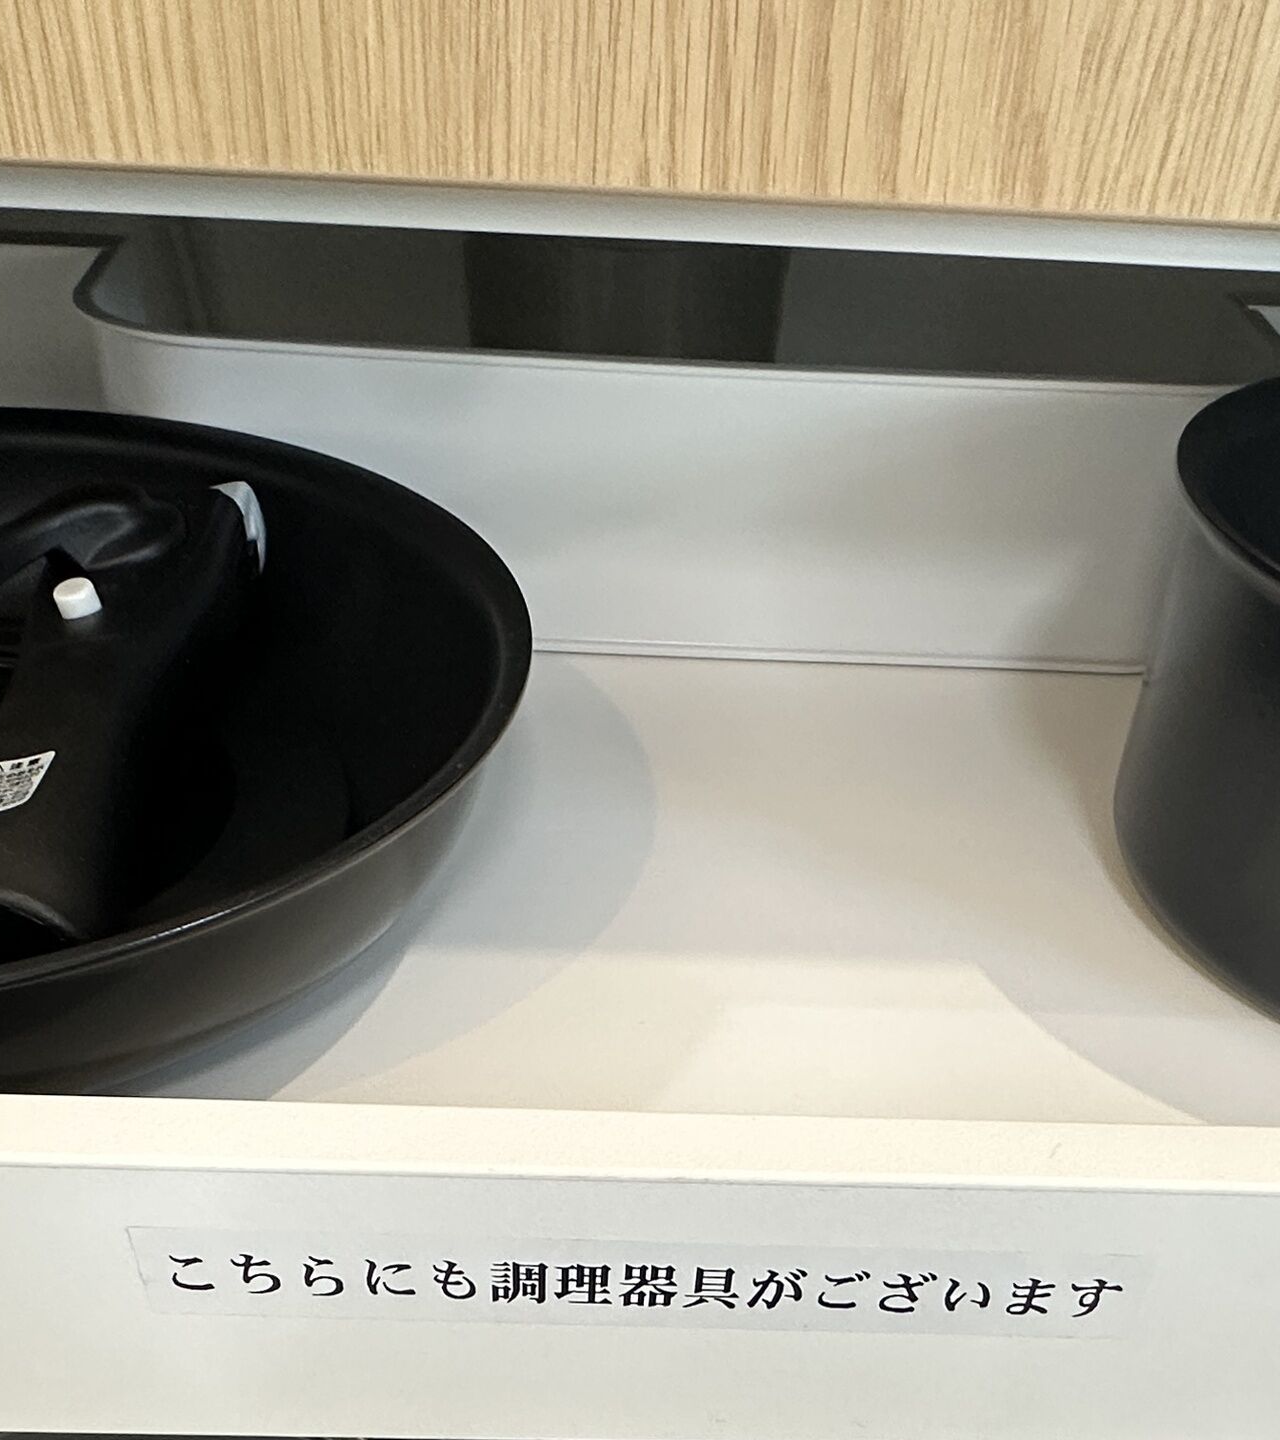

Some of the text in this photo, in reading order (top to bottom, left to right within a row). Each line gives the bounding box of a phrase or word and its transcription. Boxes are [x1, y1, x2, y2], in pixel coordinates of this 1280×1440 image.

[168, 1252, 1124, 1319] こちらにも調理器具がございます
